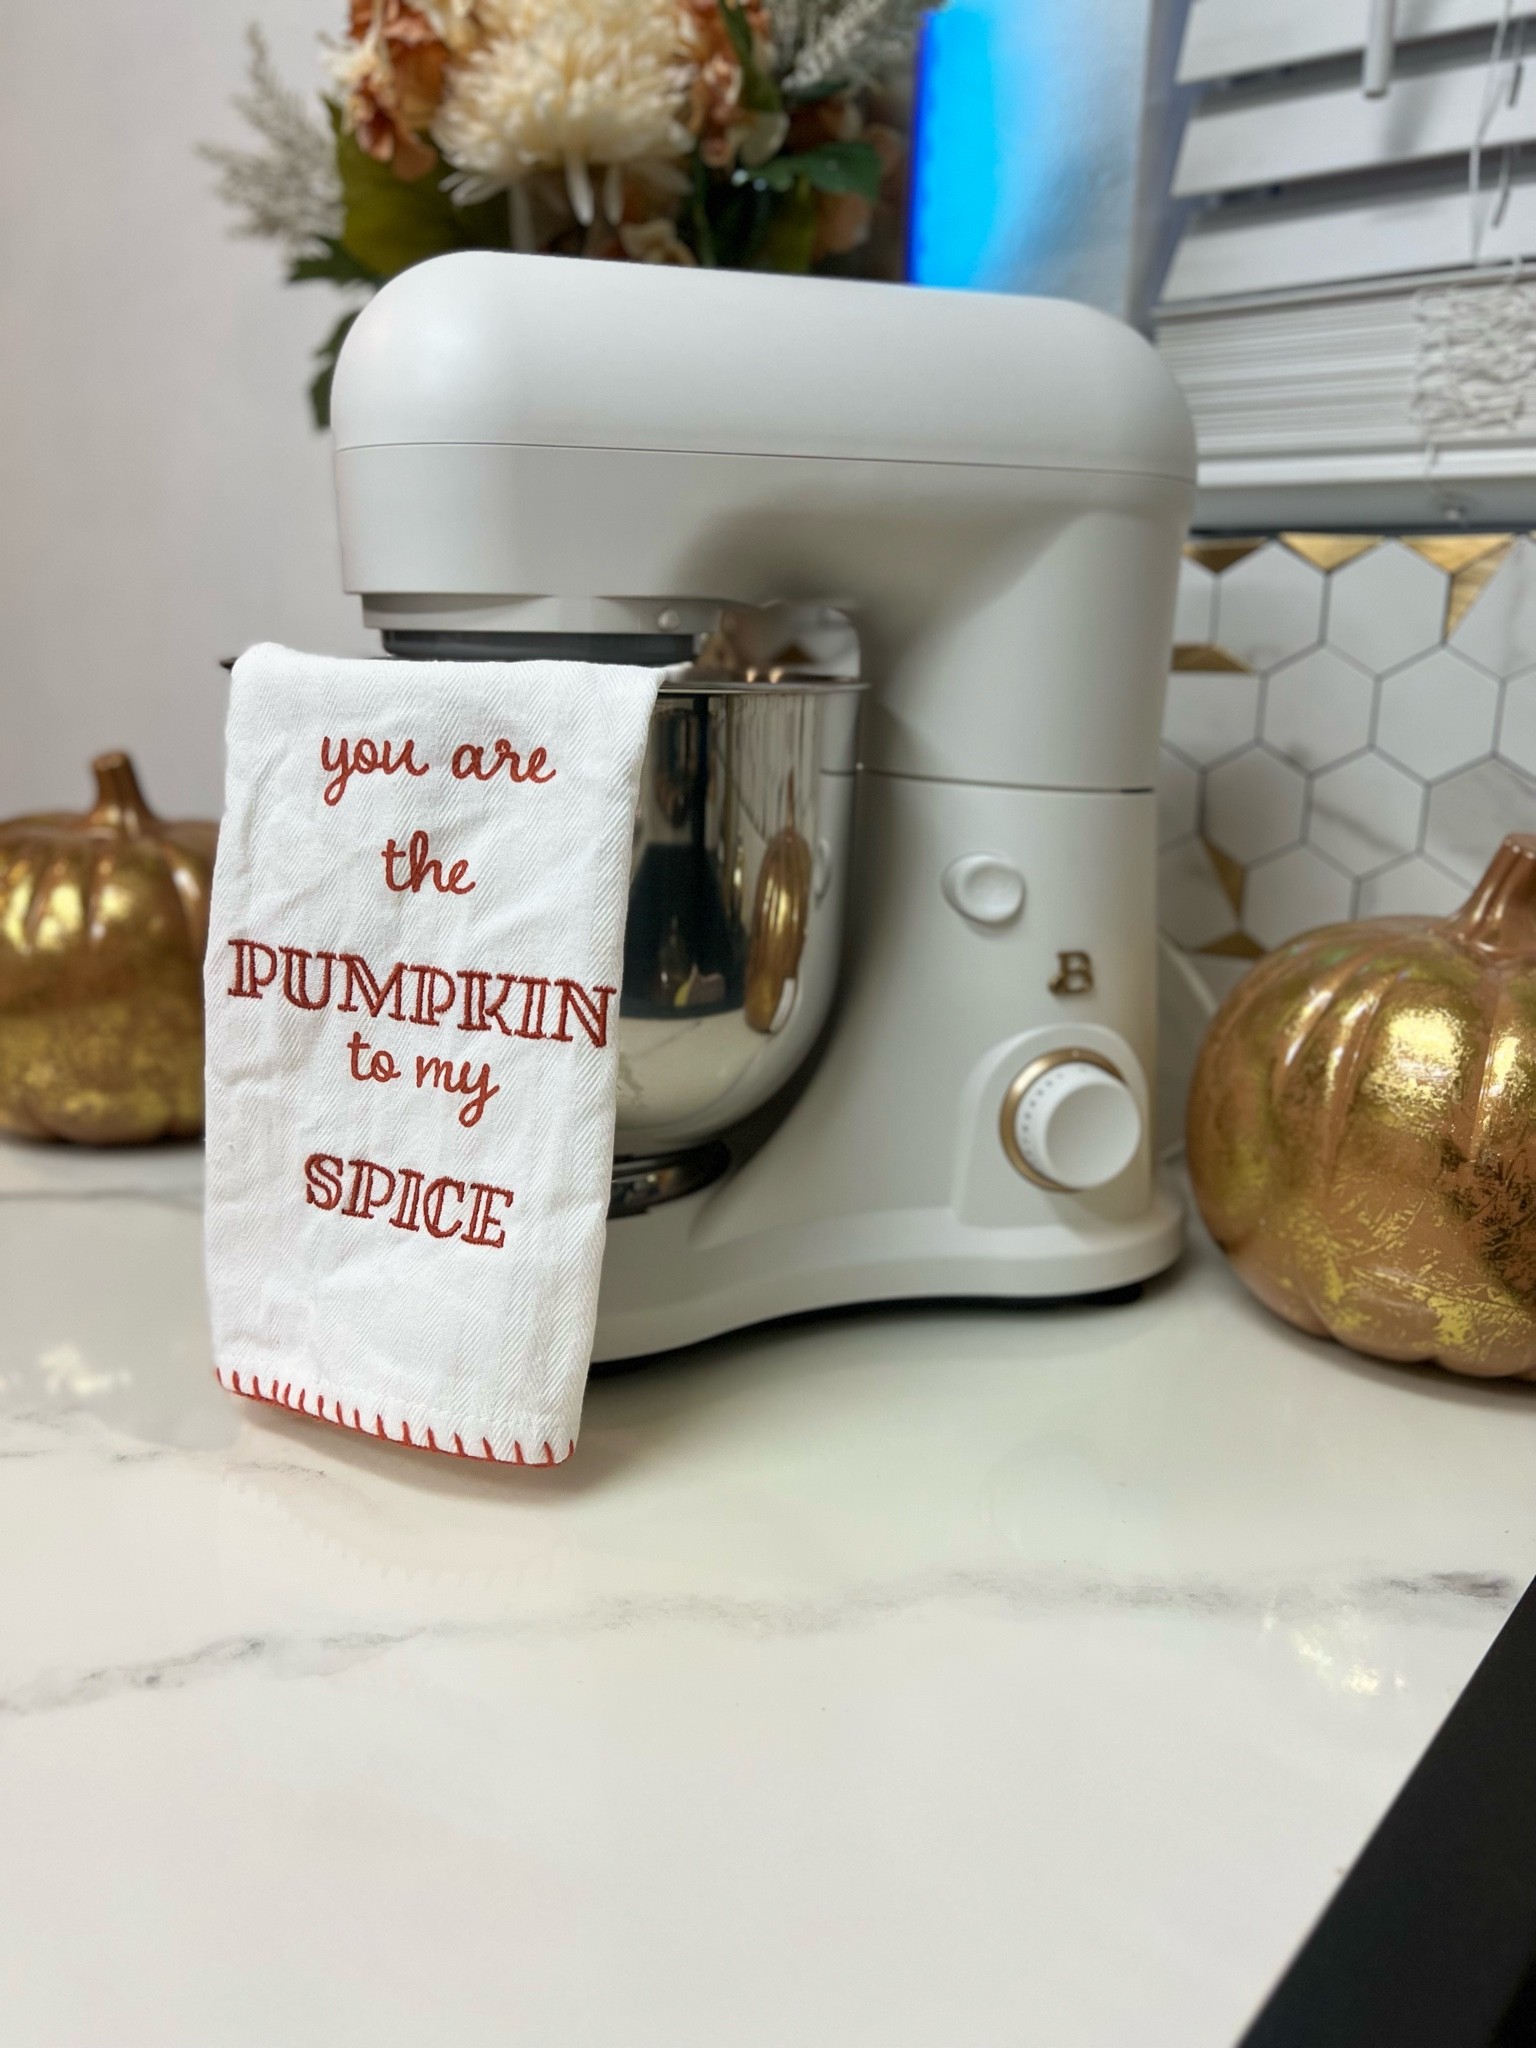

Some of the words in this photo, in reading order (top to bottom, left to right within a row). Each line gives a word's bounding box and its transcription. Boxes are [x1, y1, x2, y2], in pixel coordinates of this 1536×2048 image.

[321, 735, 429, 806] you
[451, 738, 557, 784] are
[381, 830, 476, 895] the
[227, 938, 617, 1048] PUMPKIN
[1048, 950, 1093, 995] B
[347, 1031, 401, 1083] to
[415, 1055, 500, 1128] my
[304, 1153, 514, 1249] SPICE
